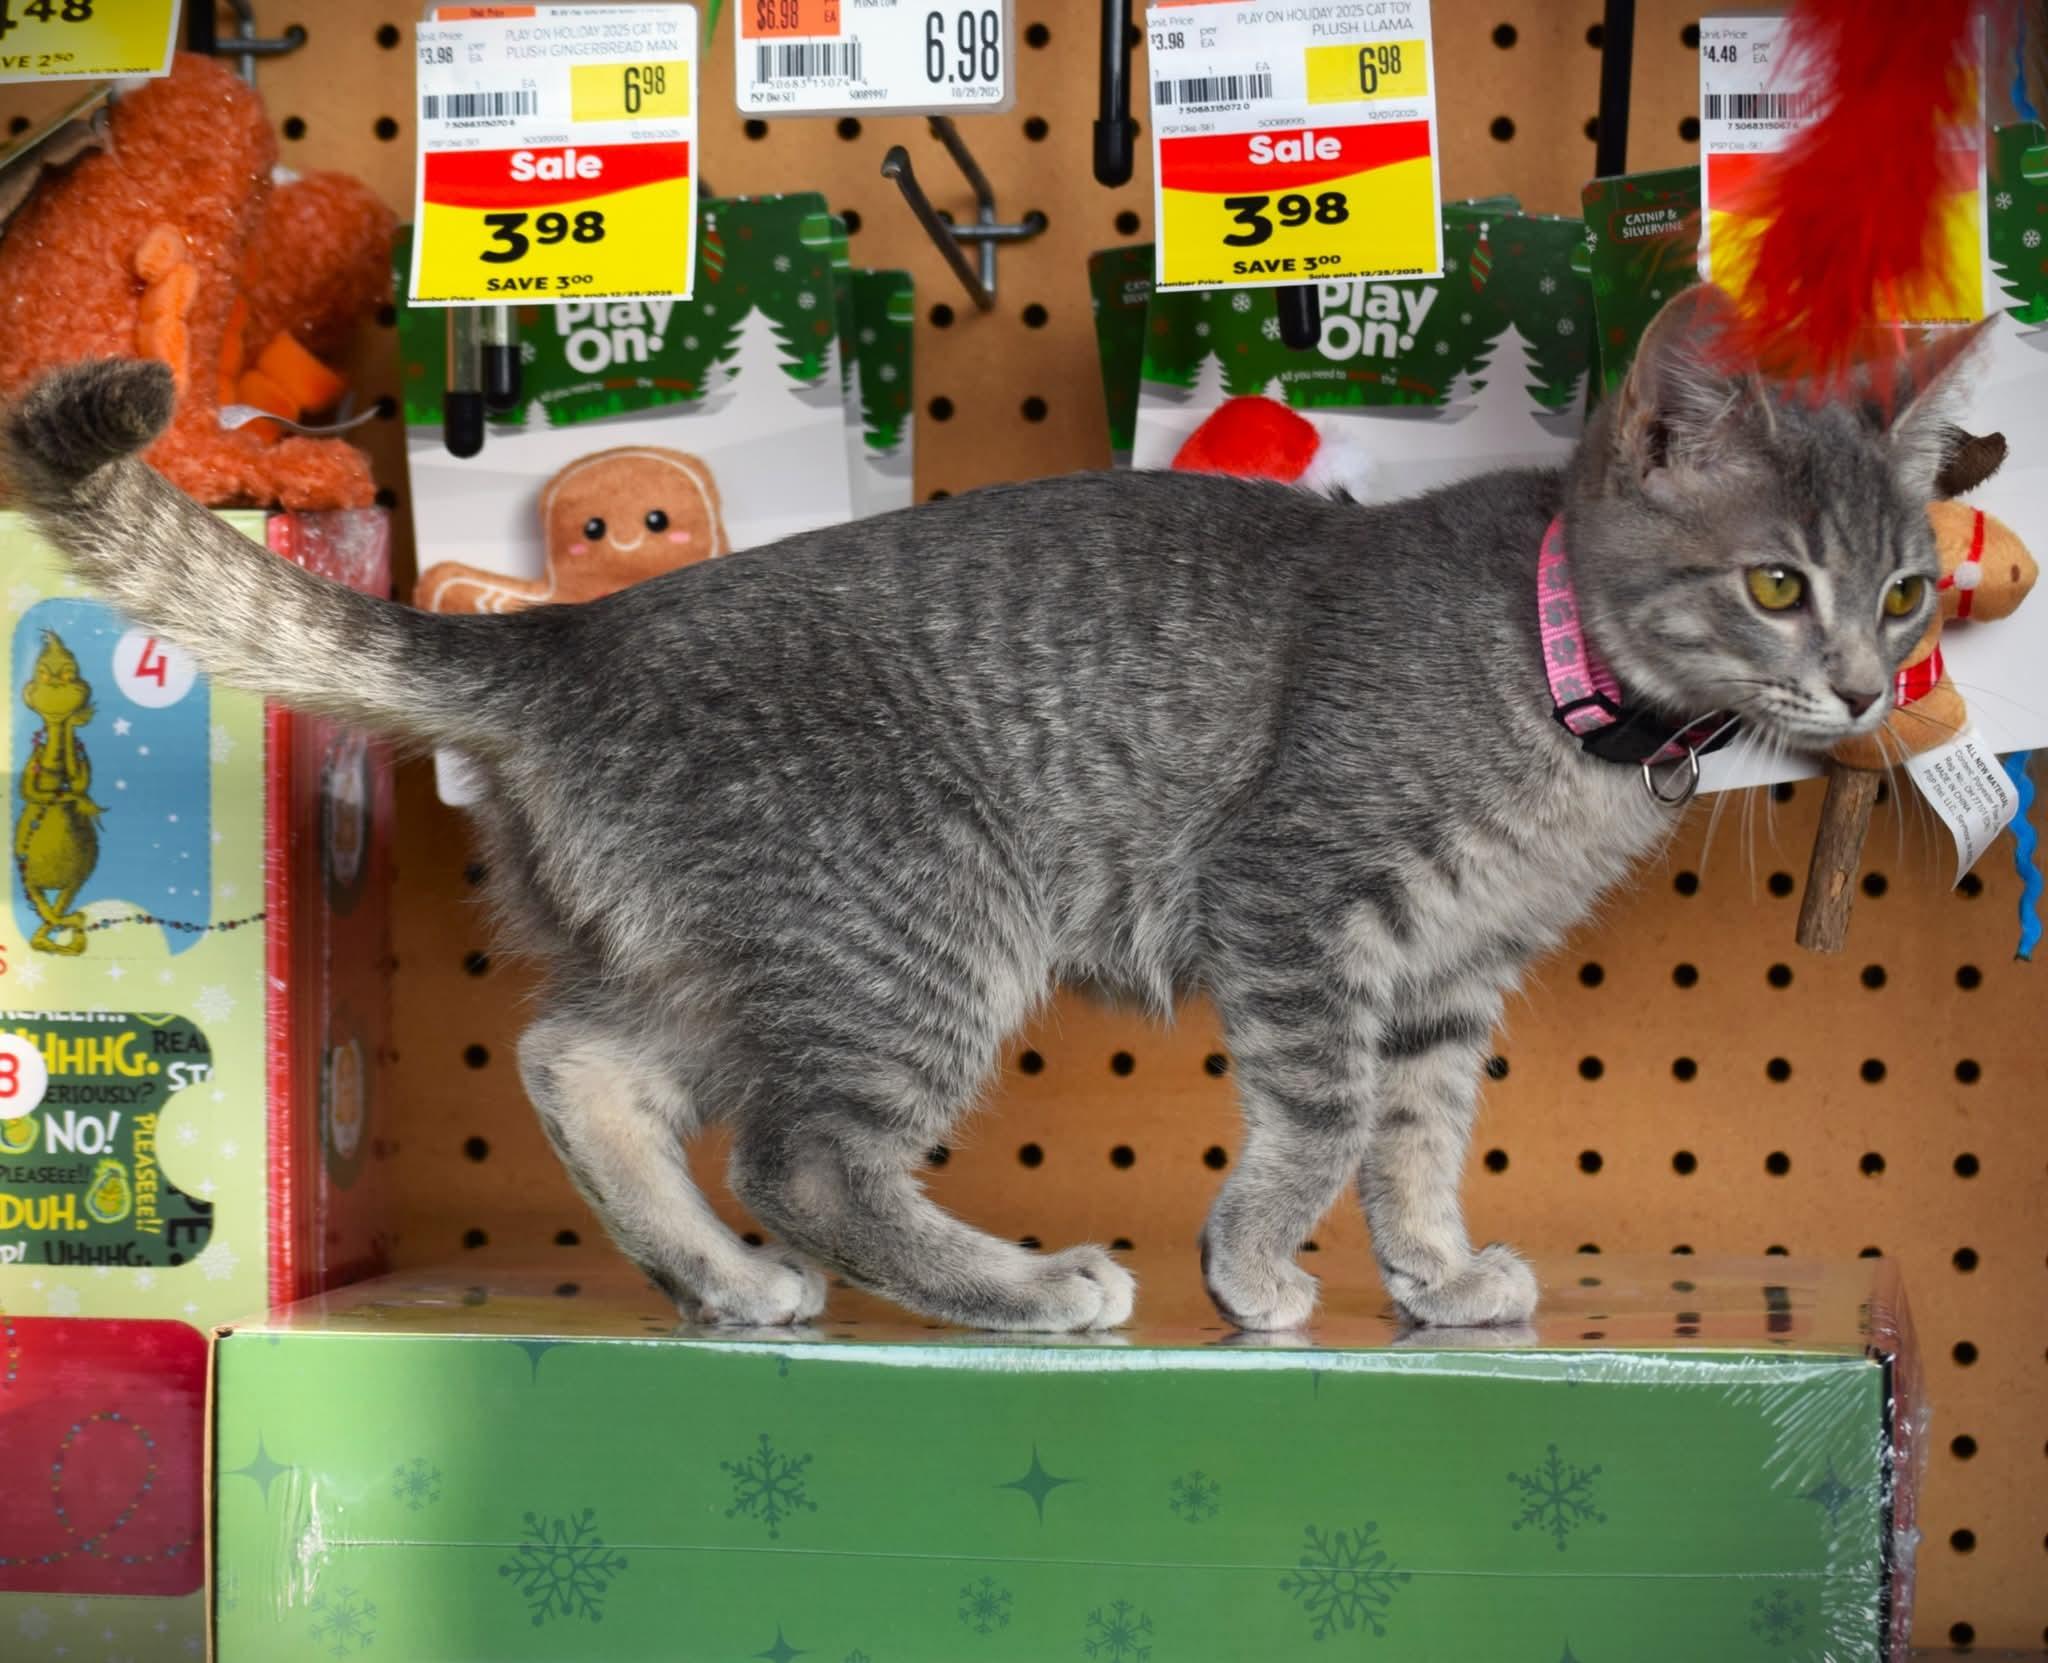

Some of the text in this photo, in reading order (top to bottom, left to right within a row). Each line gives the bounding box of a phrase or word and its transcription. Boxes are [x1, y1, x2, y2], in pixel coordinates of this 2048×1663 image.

[1169, 16, 1194, 27] Price
[1237, 2, 1412, 25] PLAY ON HOLIDAY 2025 CAT TOY
[632, 23, 652, 36] CAT
[656, 22, 678, 35] TOY
[1312, 18, 1414, 36] PLUSH LLAMA
[1722, 30, 1748, 40] Price
[506, 39, 679, 58] PLUSH GINGERBREAD MAN
[926, 10, 999, 83] 6.98
[1703, 45, 1738, 63] $4.48
[1752, 42, 1770, 52] per
[1255, 61, 1270, 72] EA
[1753, 54, 1768, 64] EA
[1249, 131, 1342, 165] Sale
[510, 149, 603, 181] Sale
[1625, 209, 1678, 226] CATNIP &
[1622, 220, 1684, 240] SILVERVINE
[1233, 258, 1297, 275] SAVE
[1308, 267, 1424, 280] Sale ends 12/25/2025
[486, 277, 549, 291] SAVE
[1198, 278, 1224, 287] Price
[555, 301, 674, 336] Play
[1319, 282, 1438, 336] Play
[134, 637, 169, 689] 4
[1964, 743, 1977, 757] ALL
[1975, 757, 1990, 774] NEW
[1953, 790, 1971, 813] CHINA
[45, 1082, 156, 1105] ERIOUSLY?
[44, 1110, 121, 1155] NO!
[0, 1193, 89, 1230] DUH.
[43, 1240, 152, 1266] UHHHG.
